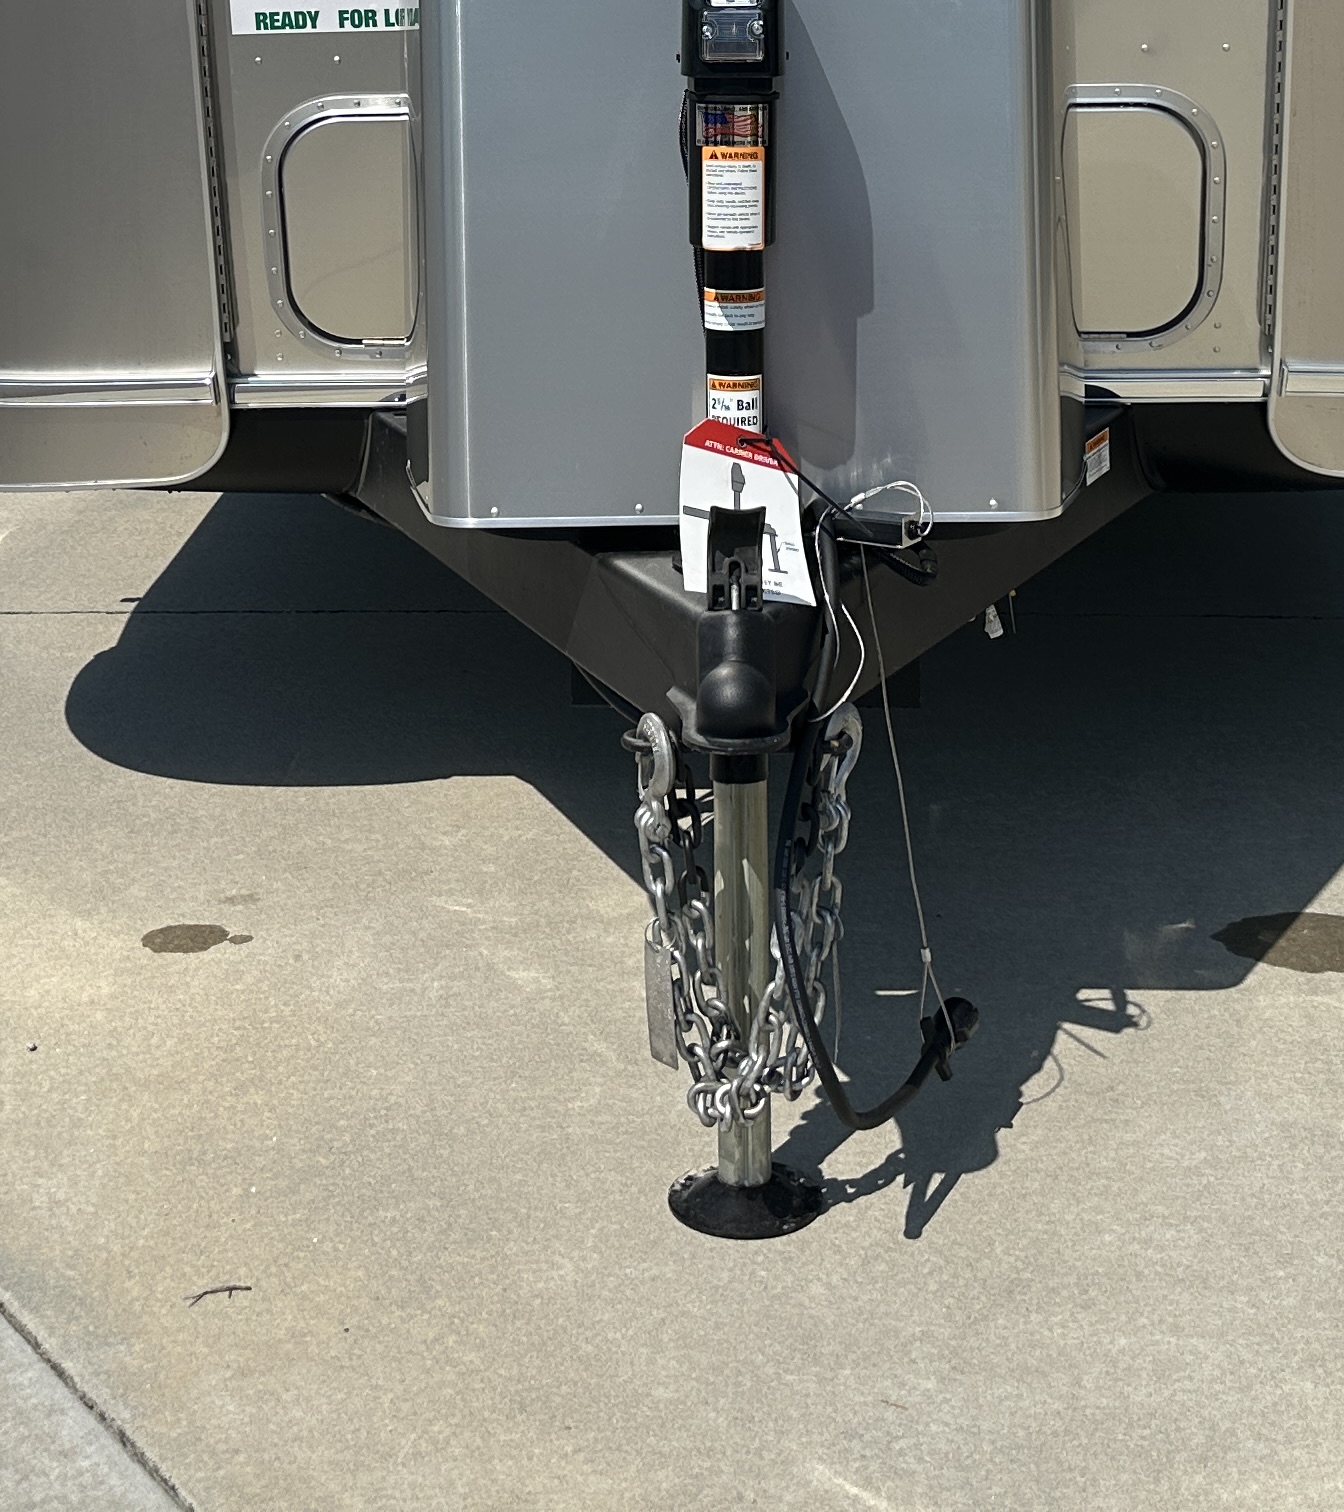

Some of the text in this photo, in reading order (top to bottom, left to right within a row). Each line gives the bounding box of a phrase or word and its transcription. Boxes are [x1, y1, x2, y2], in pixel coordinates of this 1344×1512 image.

[255, 10, 320, 30] READY
[338, 9, 378, 28] FOR
[720, 151, 759, 159] WARNING
[720, 293, 761, 302] WARNING
[718, 381, 758, 389] WARNING
[736, 396, 758, 411] Ball
[711, 415, 758, 426] QUIRED
